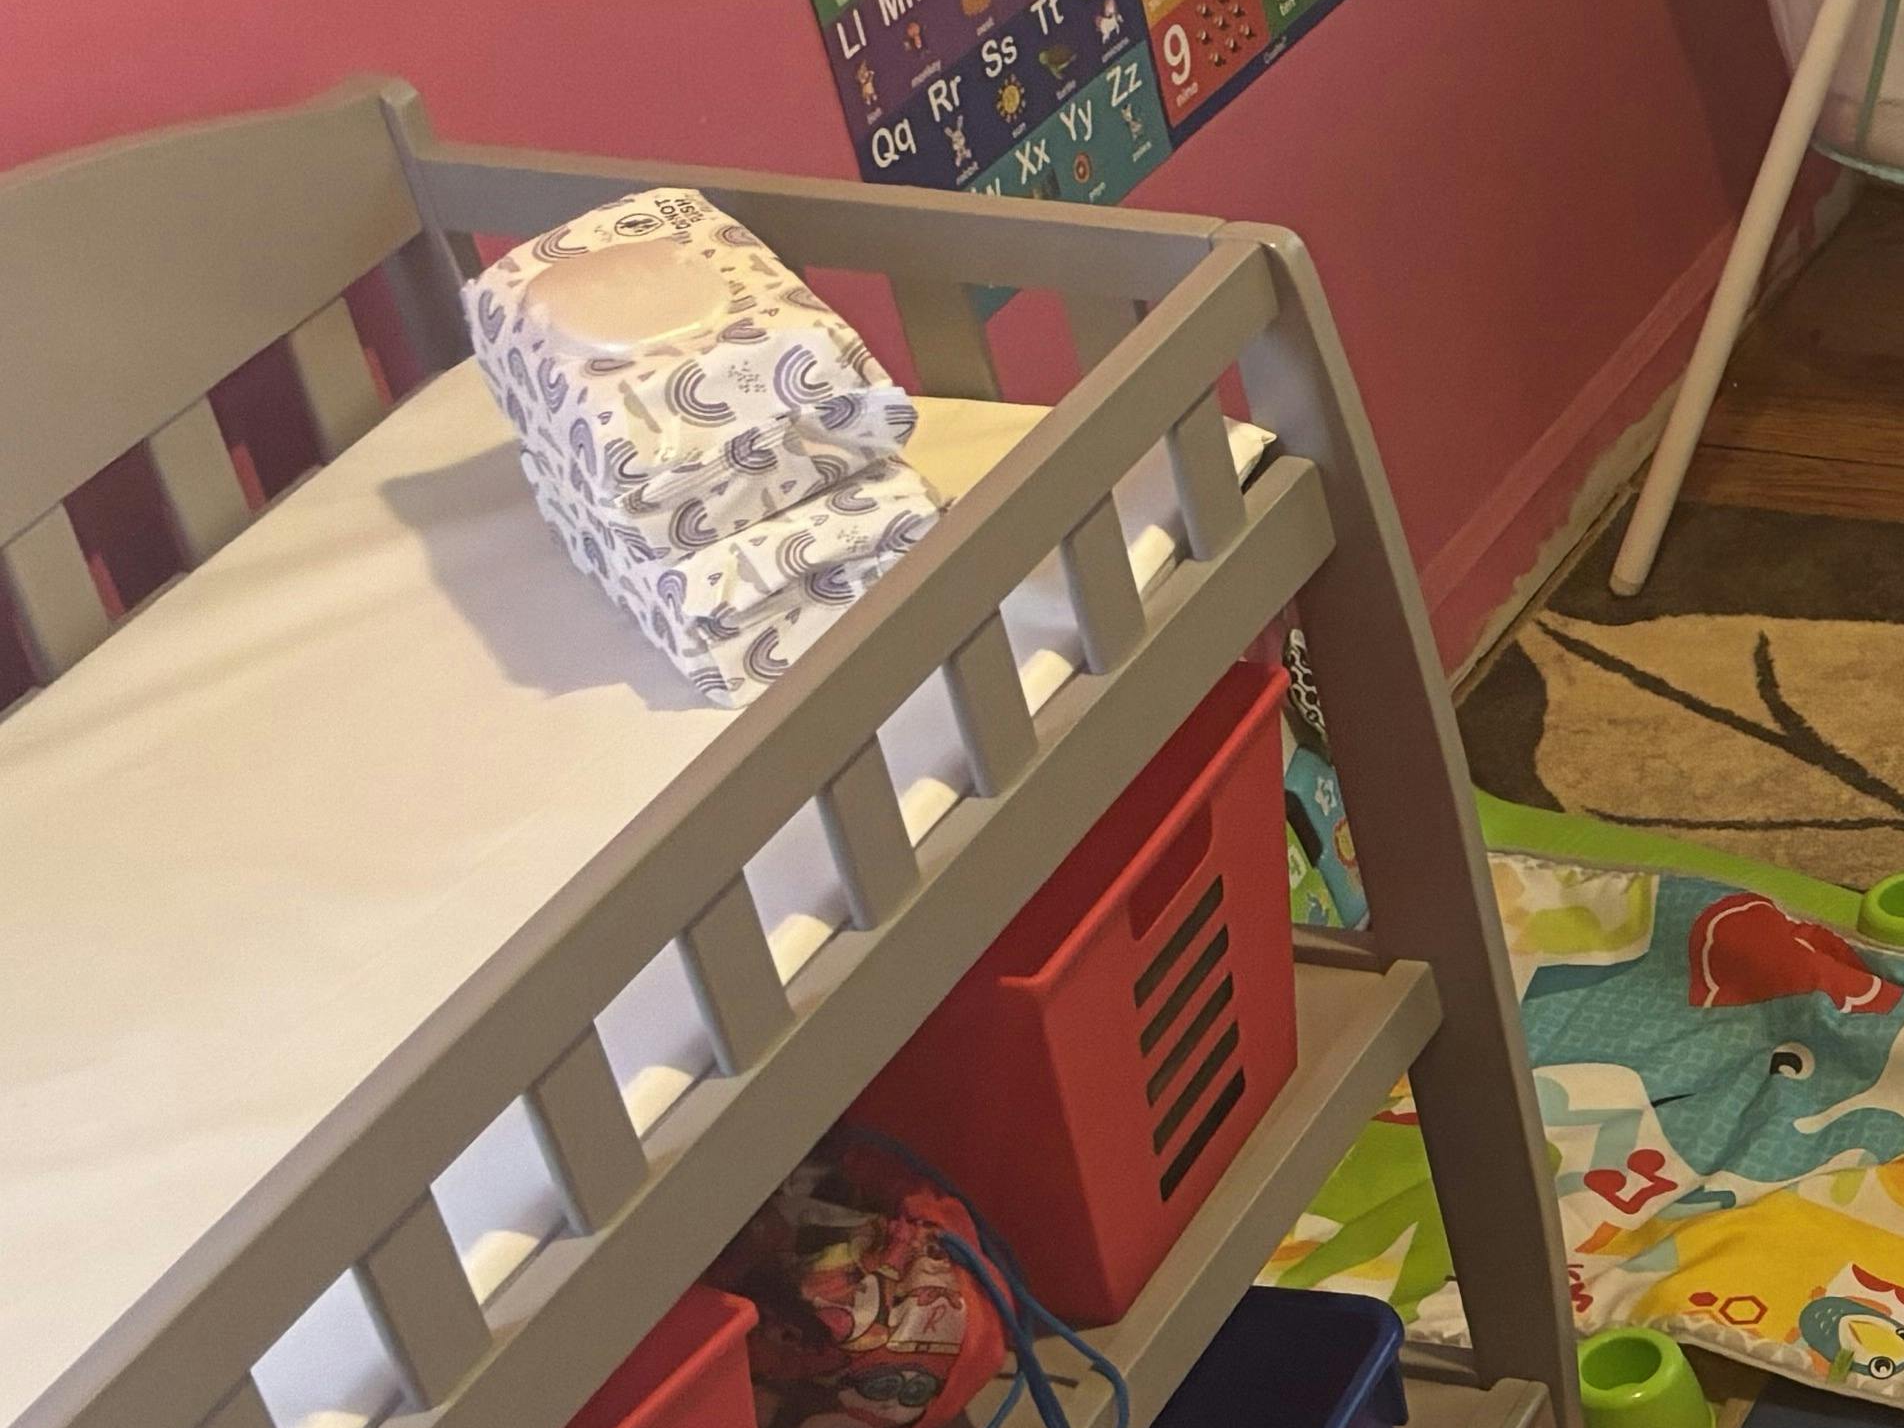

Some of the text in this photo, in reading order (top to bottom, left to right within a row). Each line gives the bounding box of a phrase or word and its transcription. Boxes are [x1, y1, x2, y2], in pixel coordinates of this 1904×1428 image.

[836, 9, 866, 61] Ll
[1163, 23, 1191, 87] 9
[871, 118, 917, 169] Qq
[927, 75, 963, 123] Rr
[981, 35, 1018, 78] Ss
[1015, 138, 1051, 185] Xx
[1060, 99, 1093, 143] Yy
[1106, 61, 1143, 108] Zz
